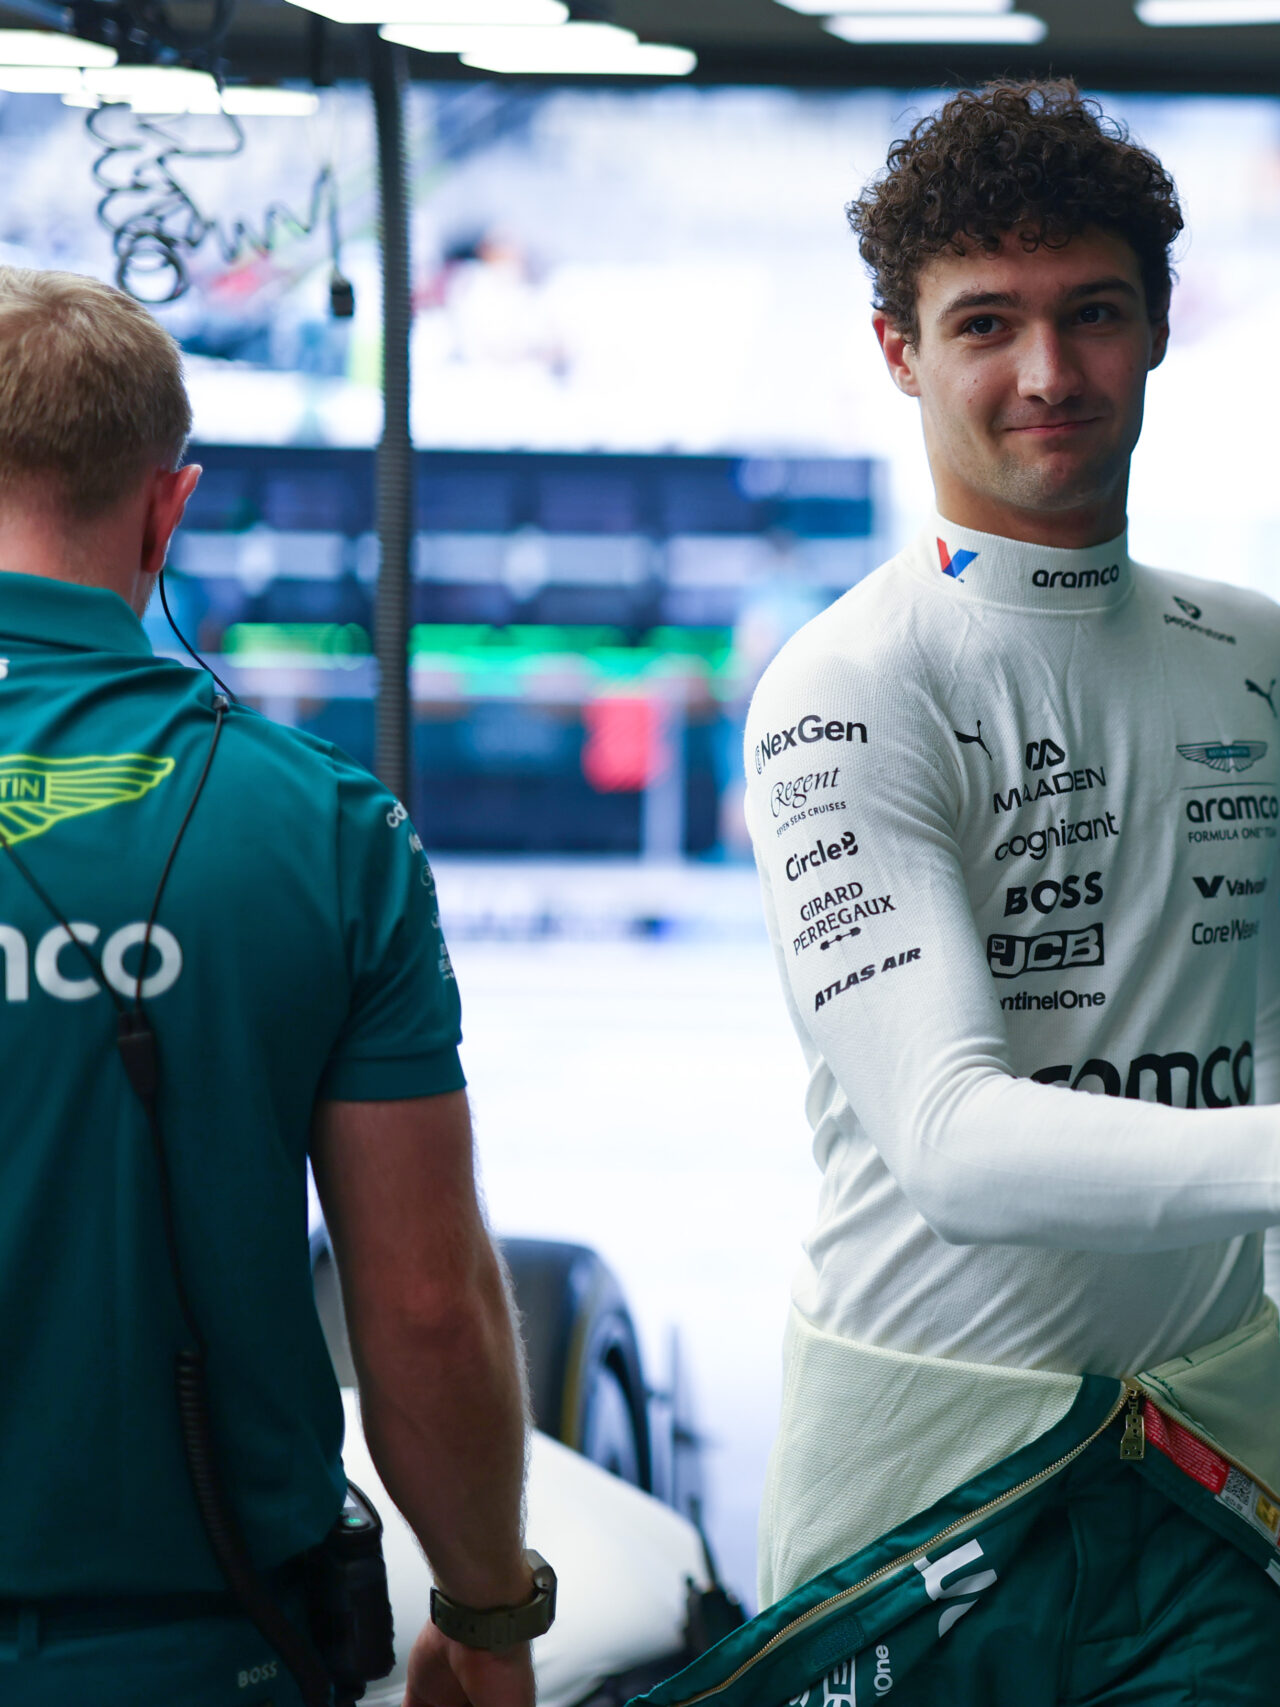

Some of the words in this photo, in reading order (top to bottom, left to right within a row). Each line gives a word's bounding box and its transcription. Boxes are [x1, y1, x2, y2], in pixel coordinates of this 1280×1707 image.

[1032, 564, 1119, 588] aramco
[760, 714, 868, 767] NexGen
[771, 767, 841, 818] Regent
[790, 811, 807, 826] SEAS
[808, 801, 847, 817] CRUISES
[993, 766, 1107, 814] MAADEN
[1186, 795, 1279, 823] aramco
[994, 811, 1119, 861] cognizant
[1188, 829, 1239, 843] FORMULA
[800, 881, 864, 922] GIRARD
[1004, 871, 1104, 917] BOSS
[793, 895, 897, 956] PERREGAUX
[990, 928, 1101, 976] JCB
[814, 964, 876, 1013] ATLAS
[881, 947, 922, 972] AIR
[1000, 989, 1106, 1011] ntinelOne
[238, 1660, 279, 1688] BOSS
[873, 1644, 894, 1697] One
